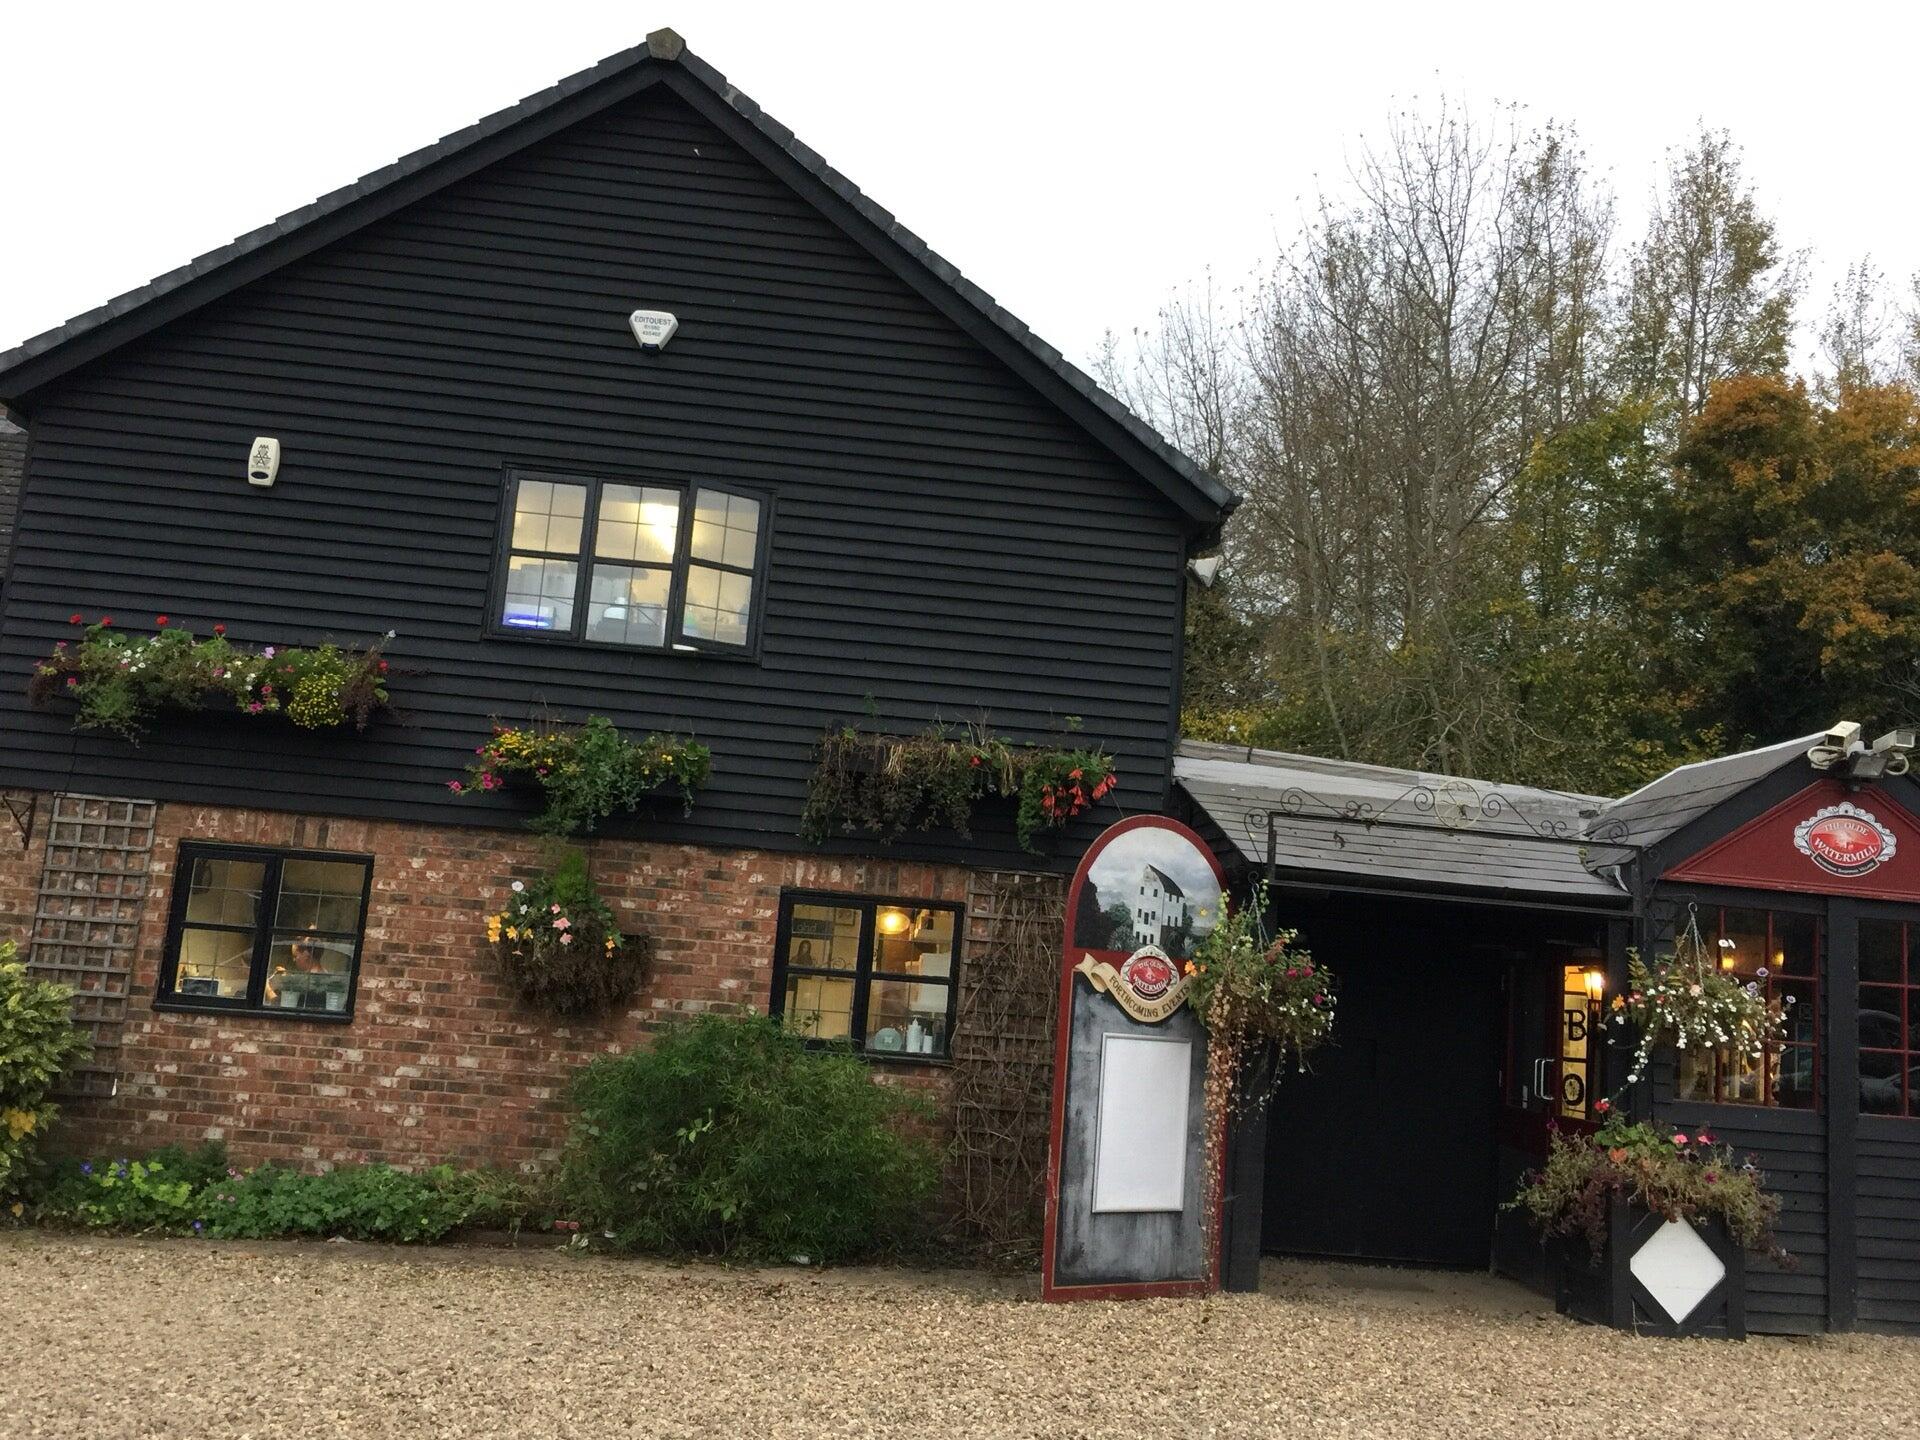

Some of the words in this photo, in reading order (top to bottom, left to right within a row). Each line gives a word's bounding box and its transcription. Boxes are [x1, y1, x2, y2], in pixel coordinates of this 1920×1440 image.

[1823, 822, 1842, 832] THE
[1844, 822, 1868, 836] OLDE
[1814, 837, 1877, 862] WATERMILL
[1109, 976, 1159, 1018] FORTHCOMING
[1162, 984, 1191, 1014] EVENTS
